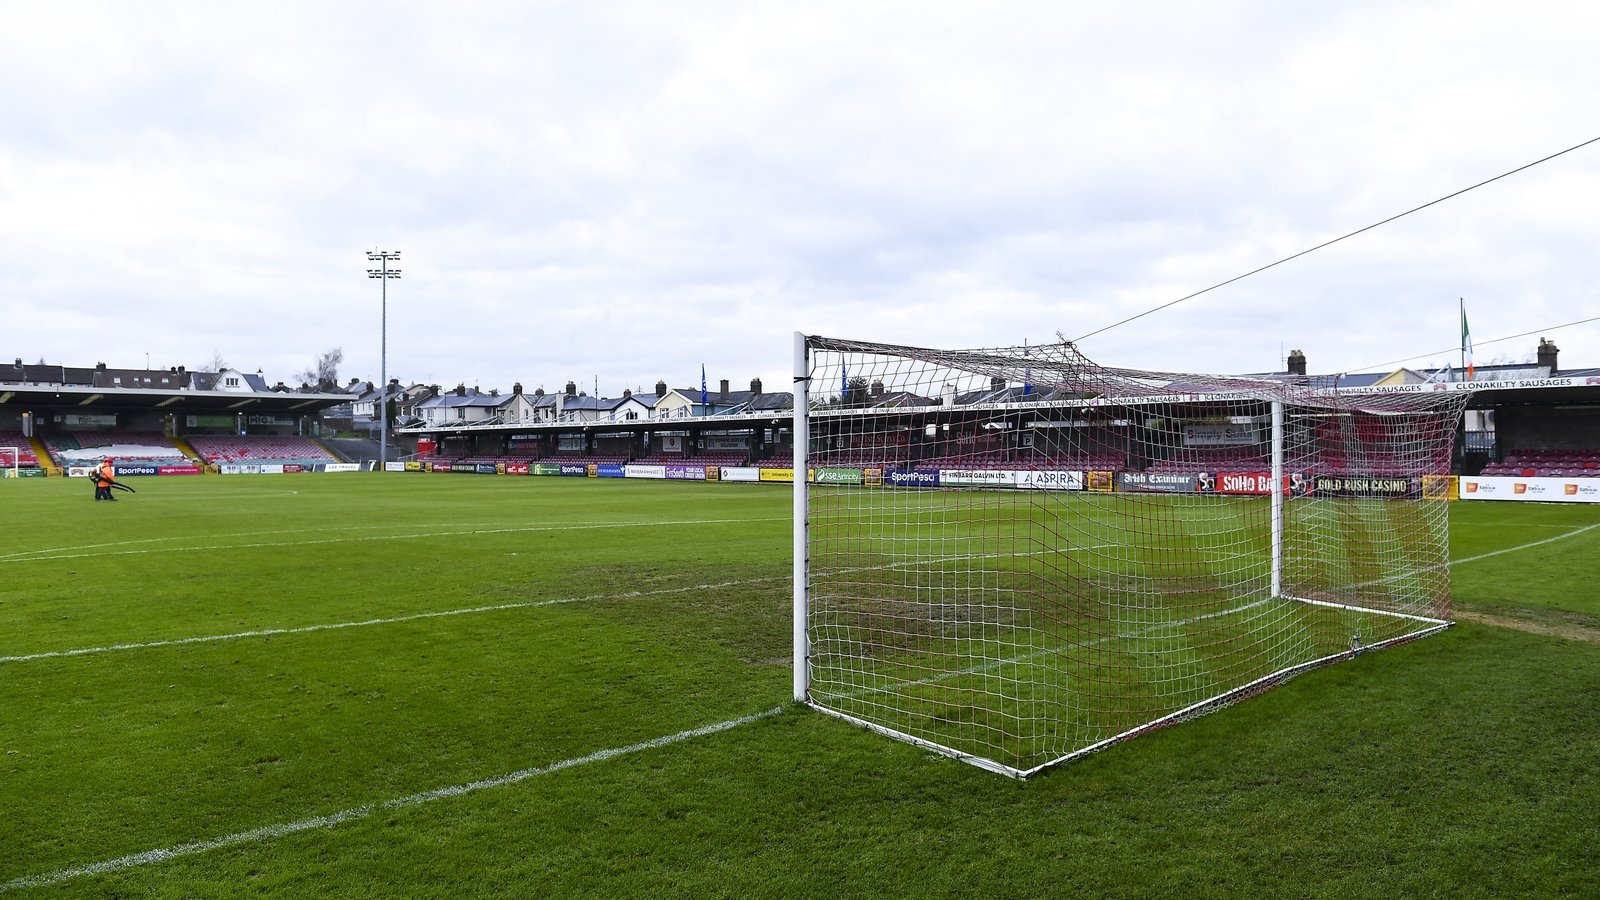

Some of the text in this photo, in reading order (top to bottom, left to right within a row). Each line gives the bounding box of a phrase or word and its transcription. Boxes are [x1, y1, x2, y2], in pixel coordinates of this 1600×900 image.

[1376, 384, 1422, 393] SAUSAGES
[1456, 378, 1572, 390] CLONAKILTY SAUSAGES
[1187, 429, 1221, 441] Simply
[118, 467, 155, 475] SportPesa
[562, 466, 584, 474] SportPesa
[974, 471, 995, 480] GALVIN
[891, 471, 935, 482] SportPesa
[1148, 473, 1190, 484] Examiner
[1318, 479, 1342, 491] GOLD
[1344, 479, 1370, 492] RUSH
[1371, 480, 1407, 492] CASINO
